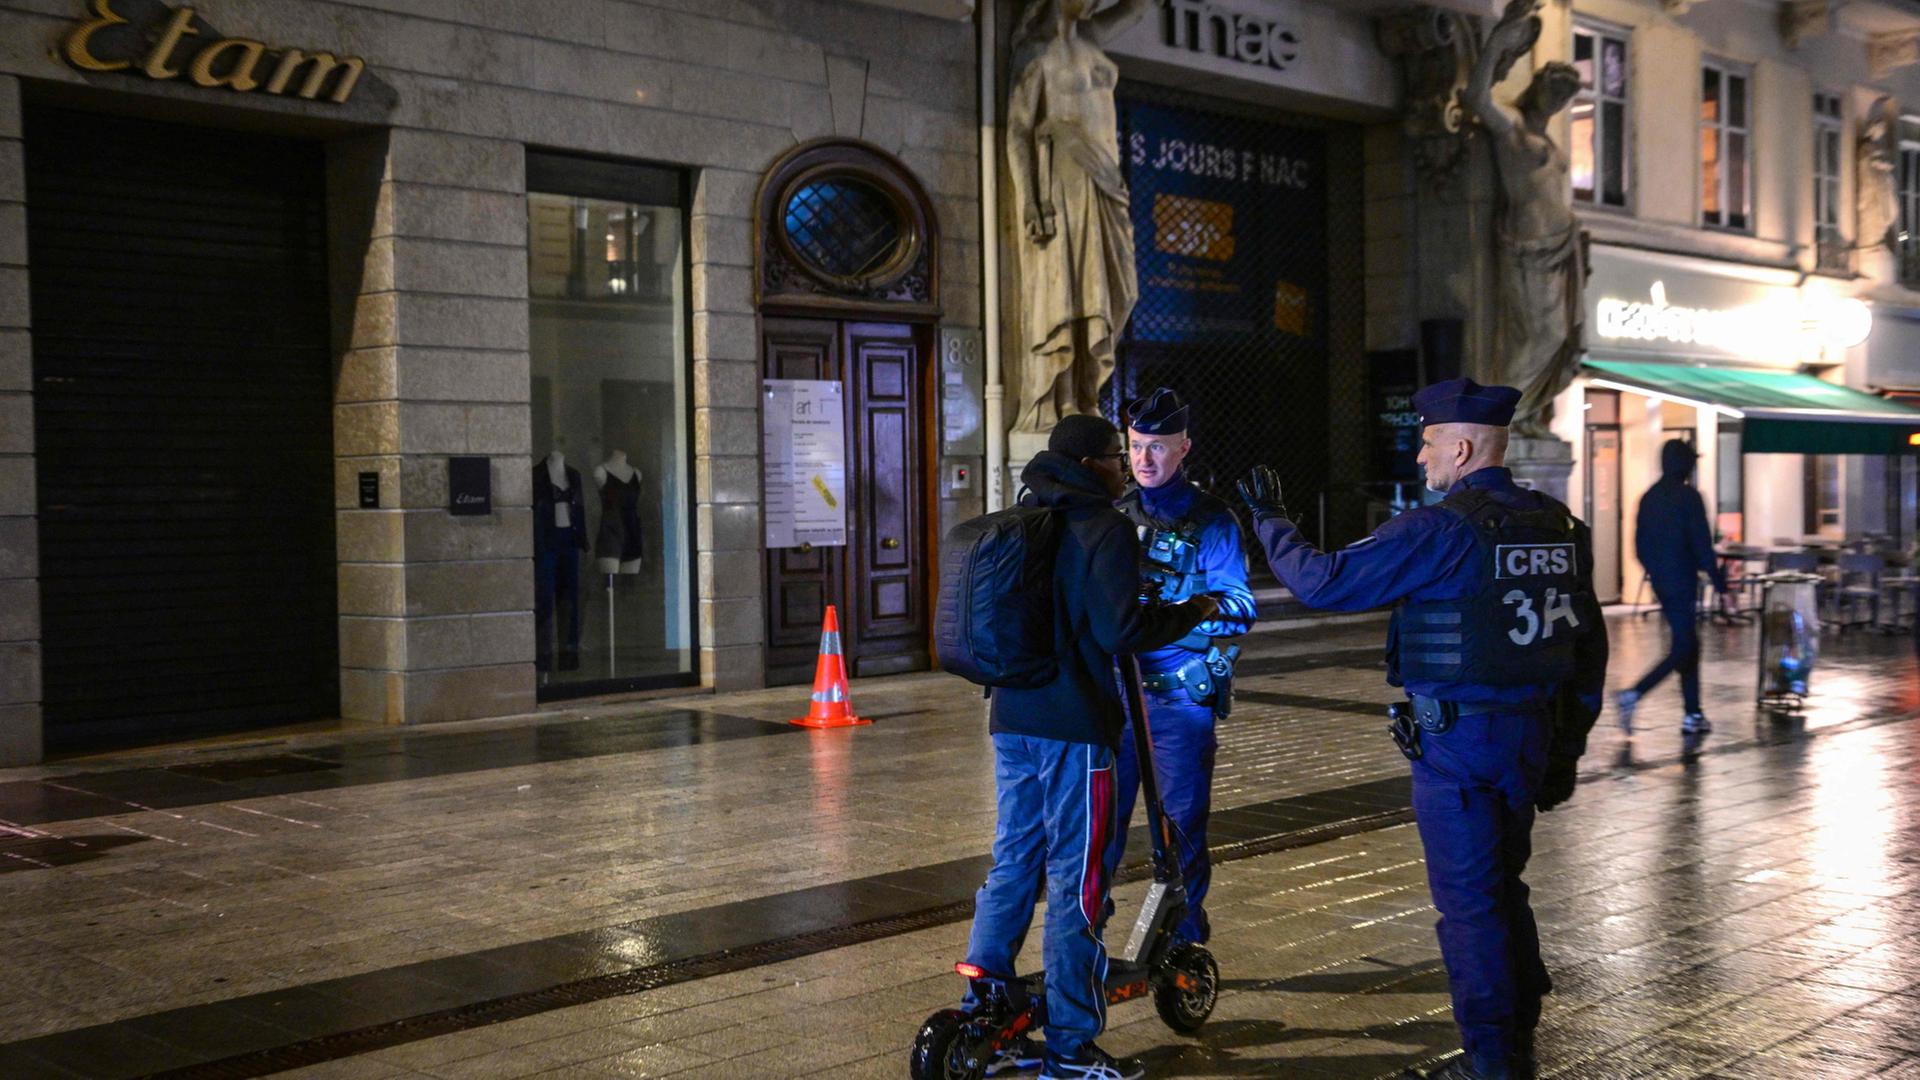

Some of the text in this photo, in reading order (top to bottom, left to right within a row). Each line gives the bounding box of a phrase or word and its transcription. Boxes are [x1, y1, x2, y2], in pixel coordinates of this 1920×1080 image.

[64, 0, 366, 104] Etam
[1151, 138, 1237, 181] JOURS
[1506, 548, 1569, 576] CRS
[1502, 587, 1580, 646] 3A
